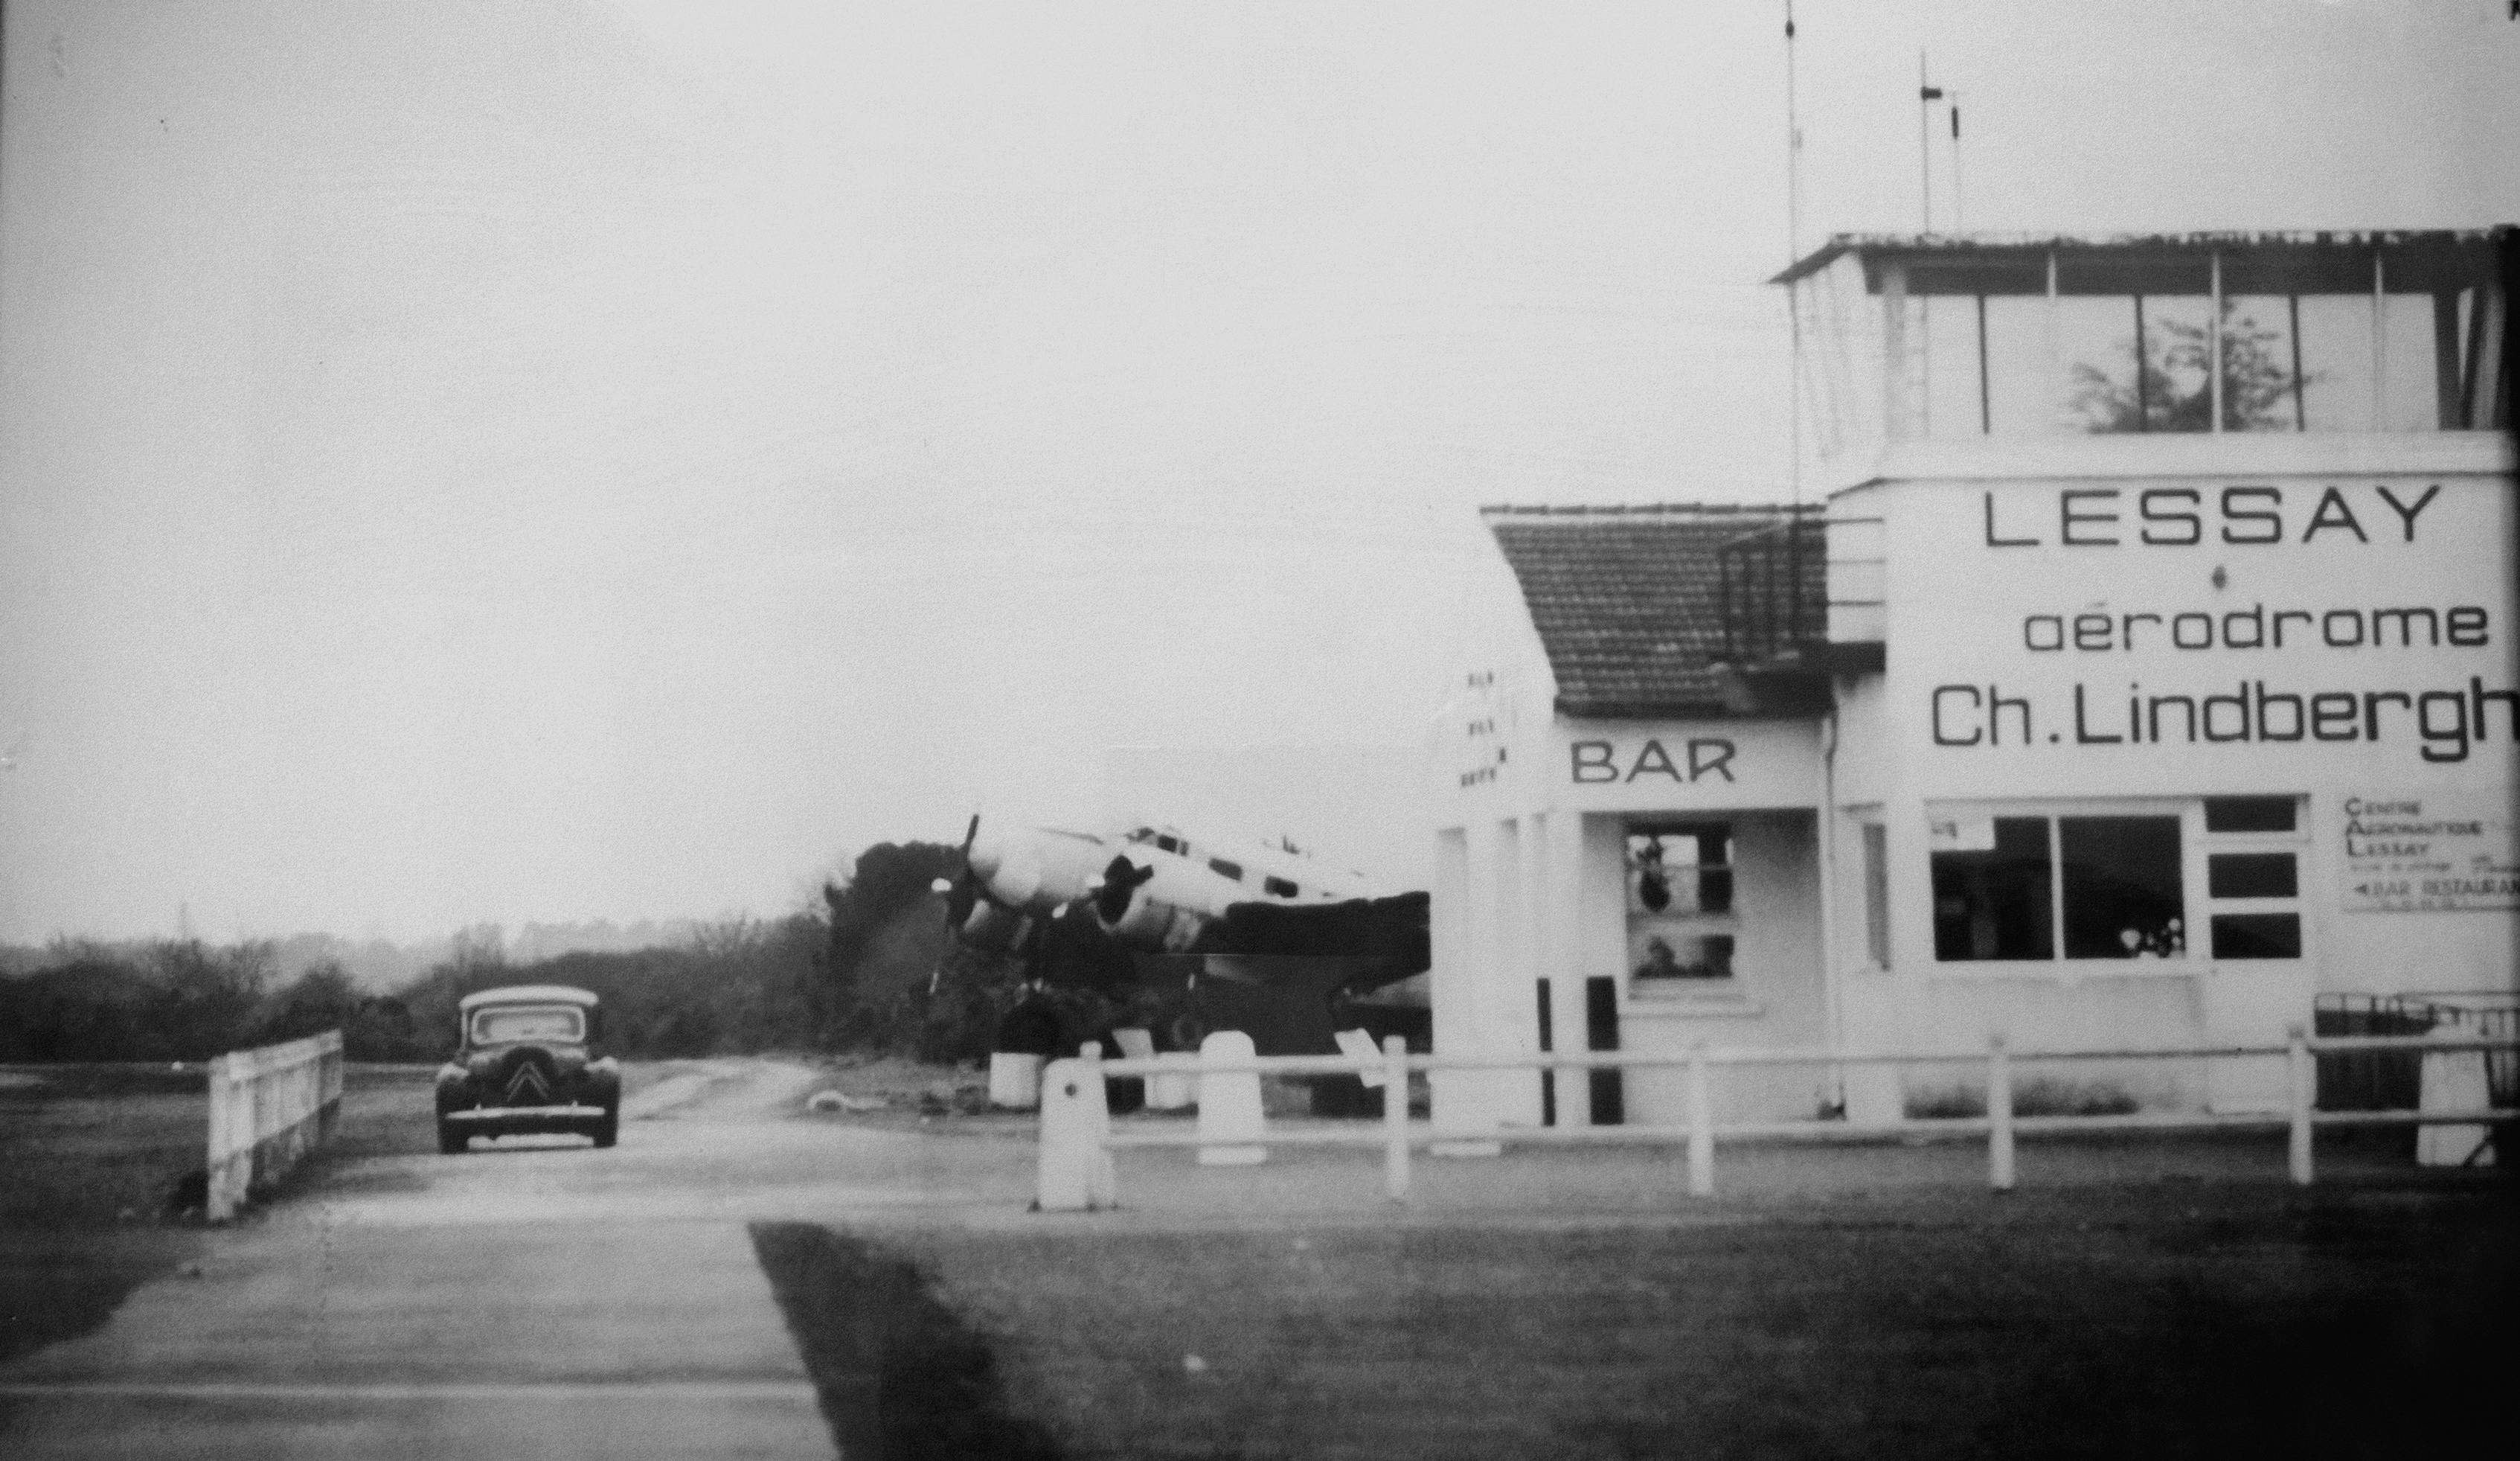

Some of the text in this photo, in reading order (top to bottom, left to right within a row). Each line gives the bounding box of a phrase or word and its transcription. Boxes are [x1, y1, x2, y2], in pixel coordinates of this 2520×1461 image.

[1985, 485, 2441, 548] LESSAY
[2023, 601, 2490, 652] aérodrome
[1571, 738, 1736, 783] BAR
